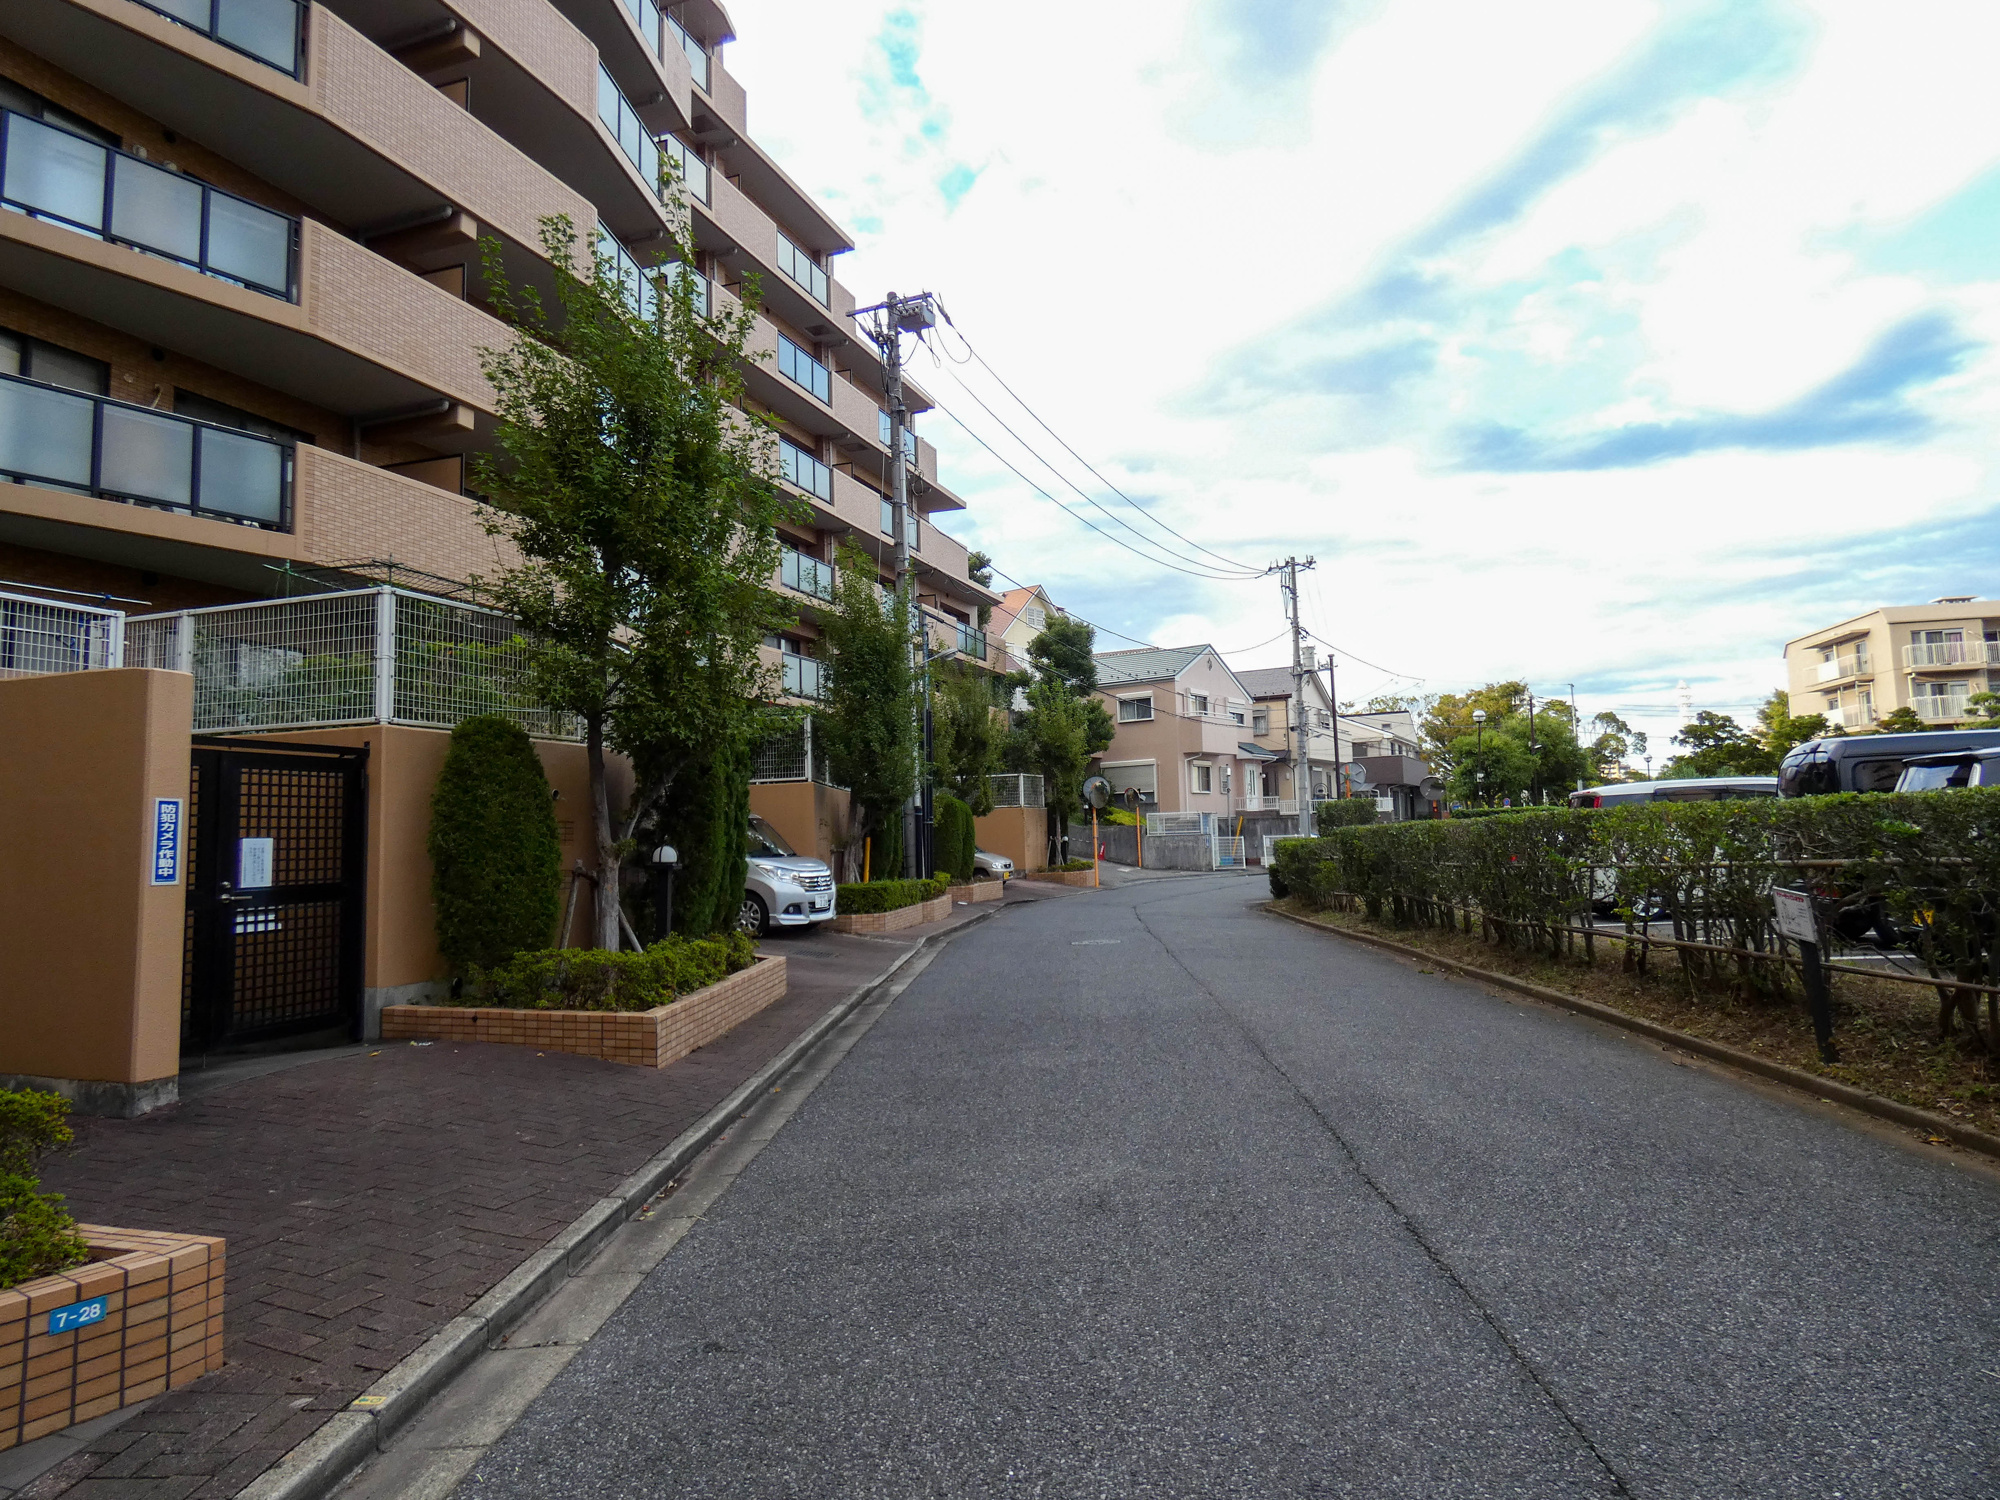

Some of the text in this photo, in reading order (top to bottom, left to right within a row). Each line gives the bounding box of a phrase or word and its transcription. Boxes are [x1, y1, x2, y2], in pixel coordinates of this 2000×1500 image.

[158, 804, 177, 877] 防犯カメラ作動中
[56, 1303, 101, 1328] 7-28
